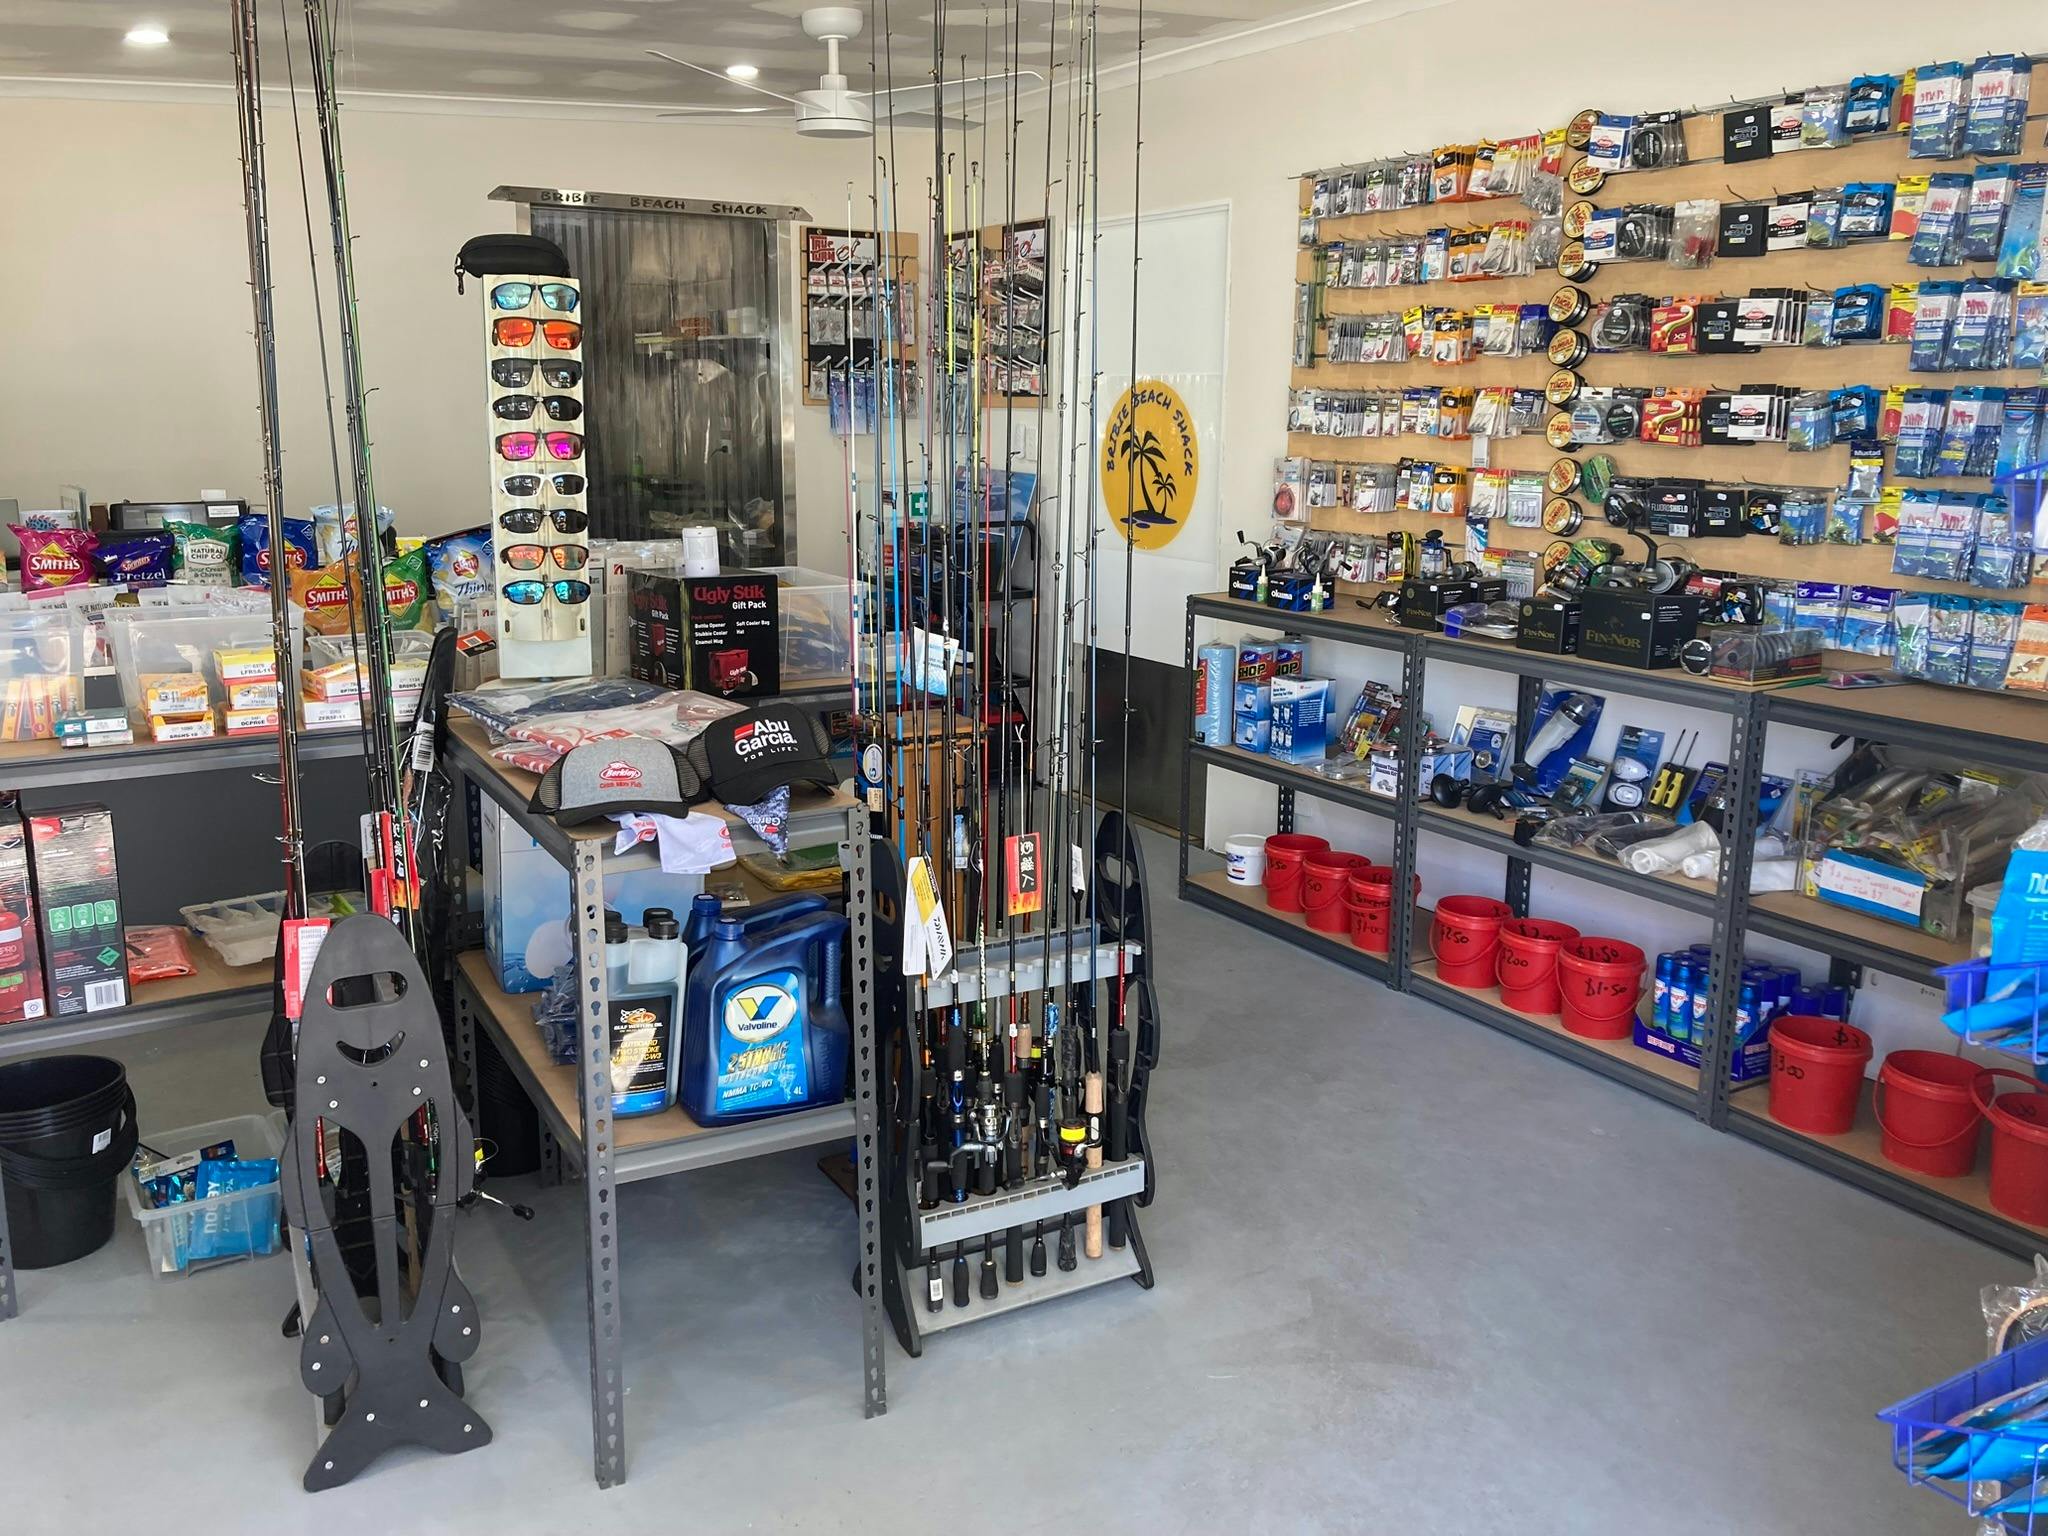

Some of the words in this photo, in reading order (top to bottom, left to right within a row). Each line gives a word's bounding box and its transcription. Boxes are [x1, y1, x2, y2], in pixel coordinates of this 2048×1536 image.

[540, 191, 600, 204] BRIBIE
[630, 197, 686, 210] BEACH
[710, 203, 768, 215] SHACK
[1107, 404, 1129, 472] BRIBIE
[1132, 389, 1172, 411] BEACH
[1173, 409, 1193, 476] SHACK
[190, 547, 224, 555] NATURAL
[31, 556, 81, 571] SMITH'S
[115, 570, 166, 582] Pretzel
[1232, 581, 1254, 591] okuma
[385, 586, 416, 601] MITH'S
[694, 586, 731, 605] Ugly
[733, 584, 767, 600] Stik
[1271, 589, 1293, 600] okuma
[732, 601, 747, 610] Gift
[748, 600, 767, 609] Pack
[754, 719, 790, 735] Abu
[744, 752, 764, 763] FOR
[606, 768, 638, 779] Berkley
[738, 1021, 778, 1033] Valvoline
[722, 1086, 747, 1098] NMMA
[749, 1079, 774, 1093] TC-W3
[793, 1086, 804, 1095] 4L
